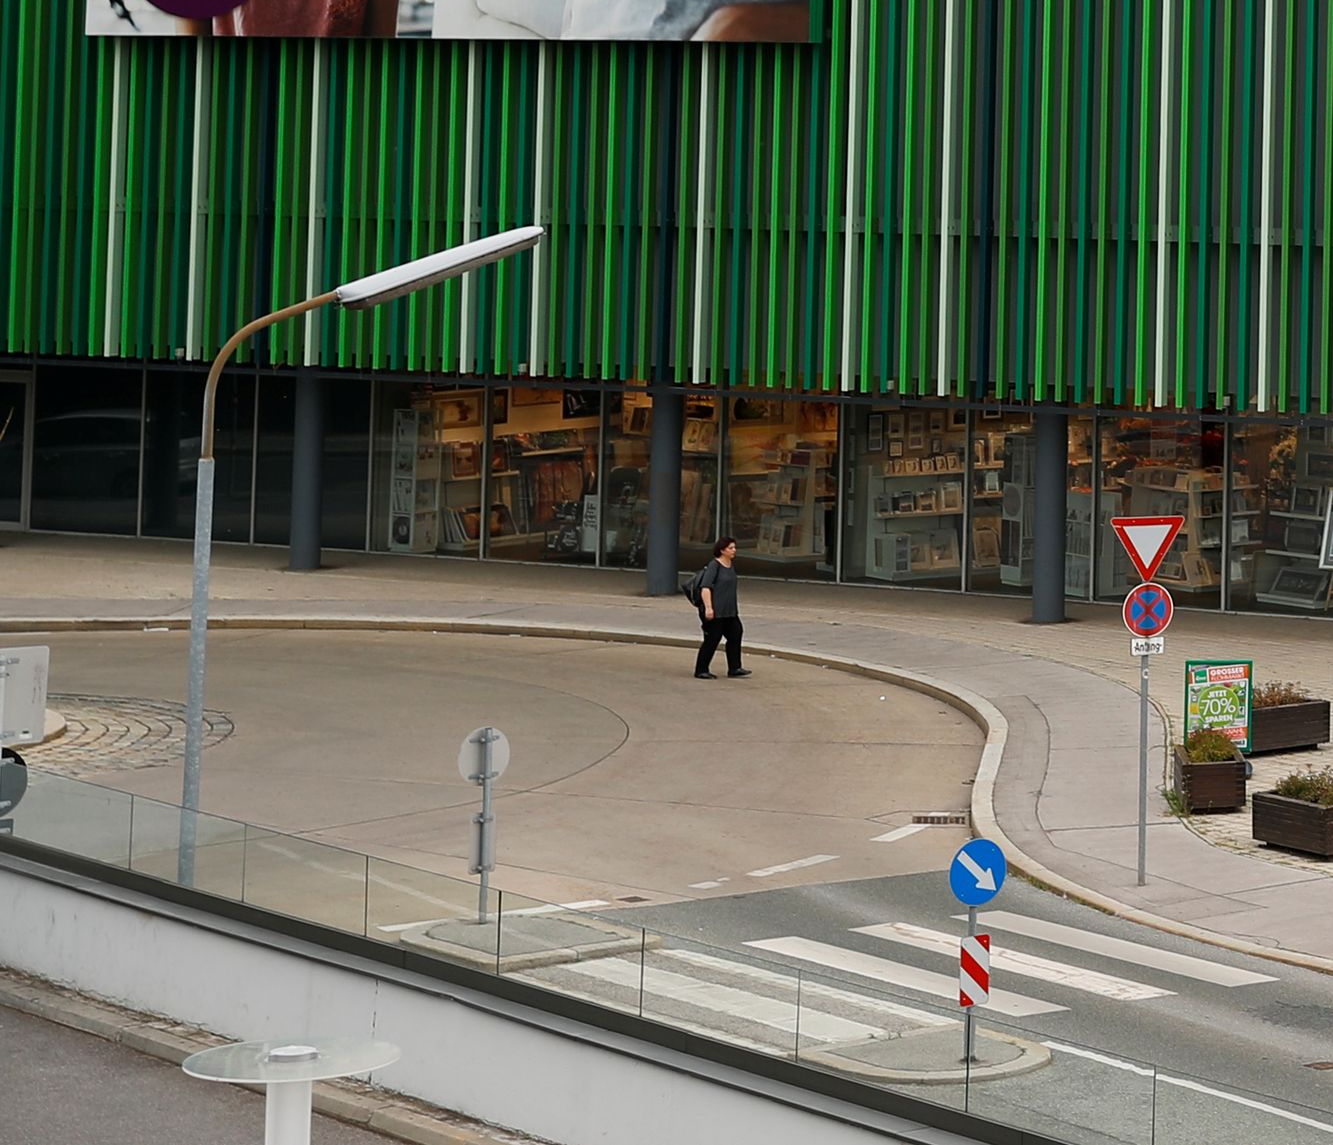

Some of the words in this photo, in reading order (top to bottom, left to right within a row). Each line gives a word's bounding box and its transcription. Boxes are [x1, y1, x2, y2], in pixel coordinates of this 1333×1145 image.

[1210, 666, 1245, 676] GROSSER
[1207, 689, 1228, 699] JETZT
[1199, 697, 1236, 716] -70%
[1204, 714, 1233, 723] SPAREN
